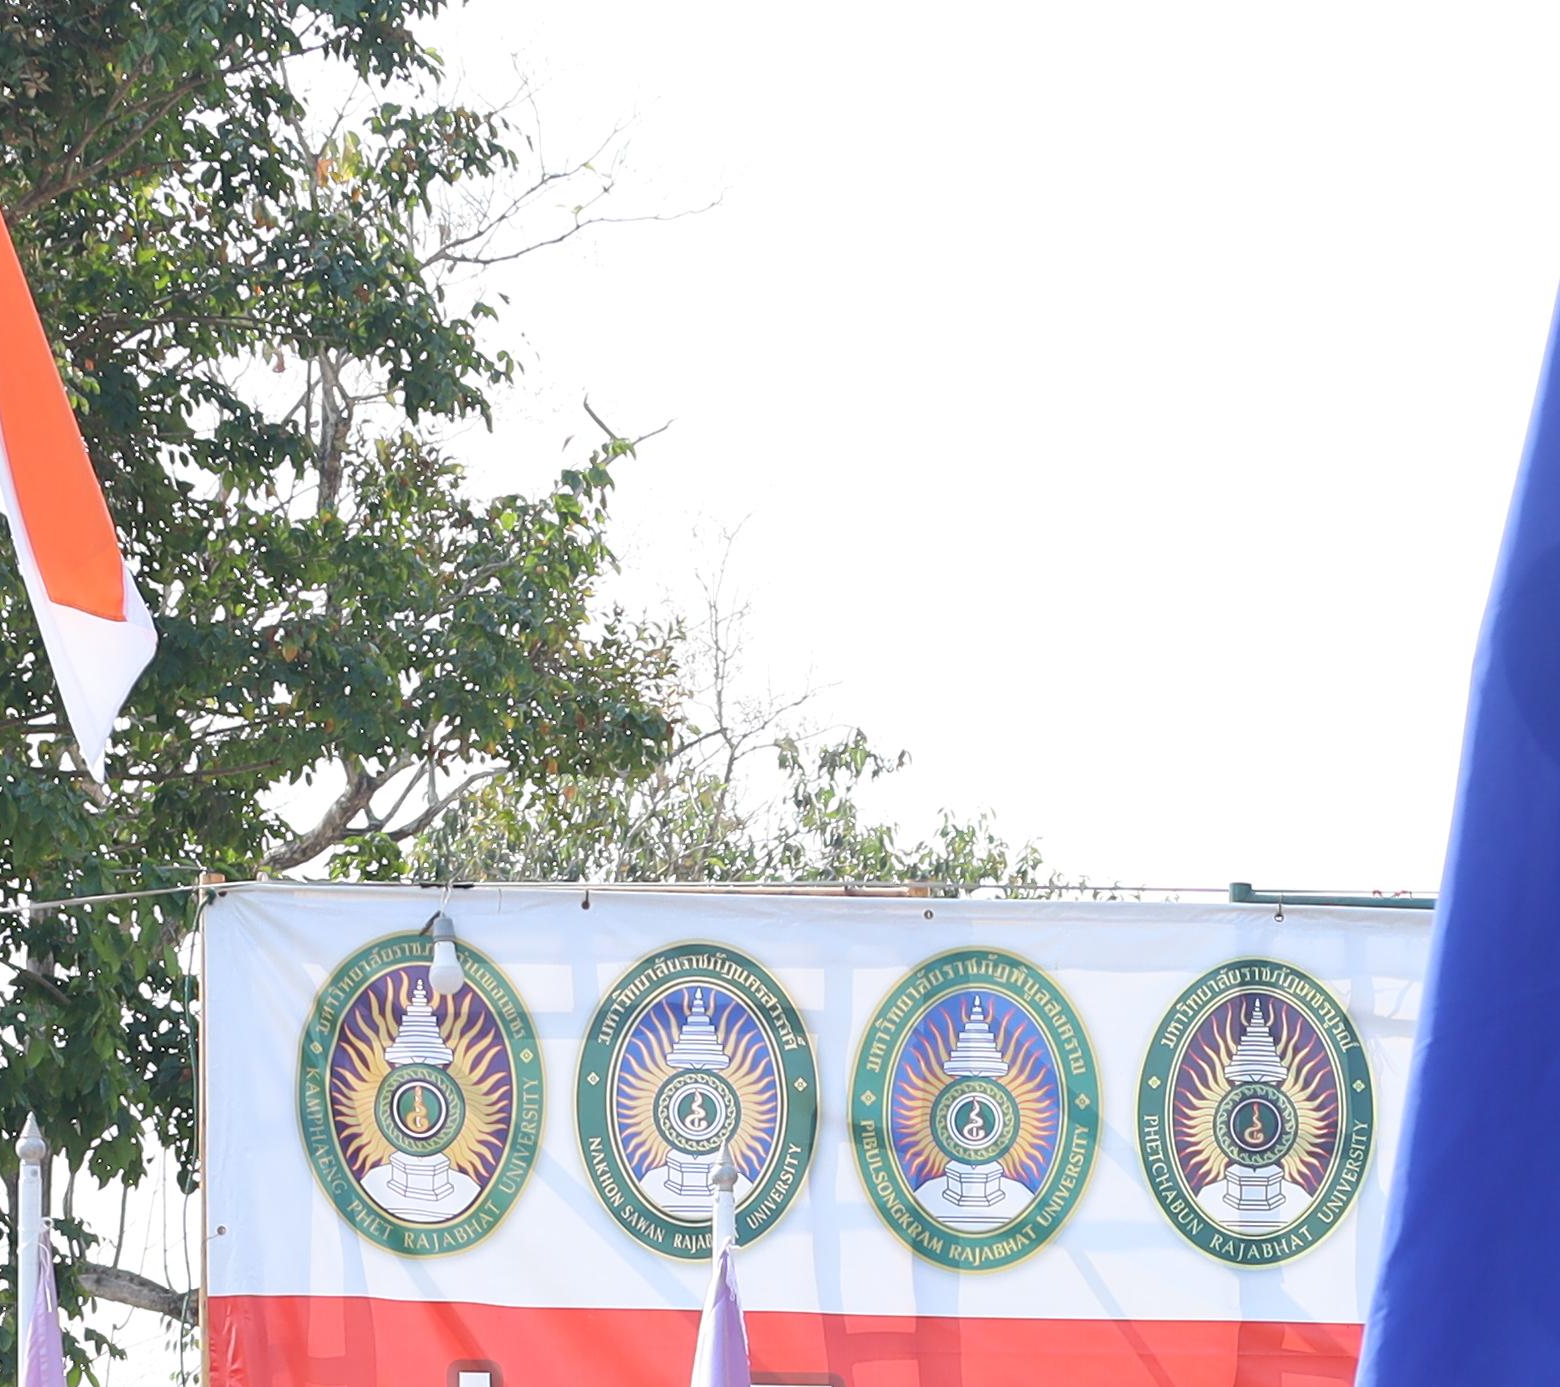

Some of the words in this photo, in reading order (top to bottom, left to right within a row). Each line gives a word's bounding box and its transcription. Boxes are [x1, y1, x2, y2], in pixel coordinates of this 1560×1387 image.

[304, 1066, 348, 1199] KAMPHAENG
[347, 1198, 393, 1243] PHET
[403, 1199, 501, 1252] RAJABHAT
[498, 1076, 540, 1197] UNIVERSITY
[587, 1135, 624, 1212] NAKHON
[619, 1202, 666, 1246] SAWAN
[672, 1232, 714, 1255] RAJAB
[746, 1141, 803, 1231] UNIVERSITY
[858, 1118, 945, 1256] PIBULSONGKRAM
[947, 1223, 1038, 1267] RAJABHAT
[1036, 1122, 1088, 1226] UNIVERSITY
[1143, 1112, 1205, 1236] PHETCHABUN
[1208, 1226, 1314, 1262] RAJABHAT
[1320, 1118, 1370, 1224] UNIVERSITY
